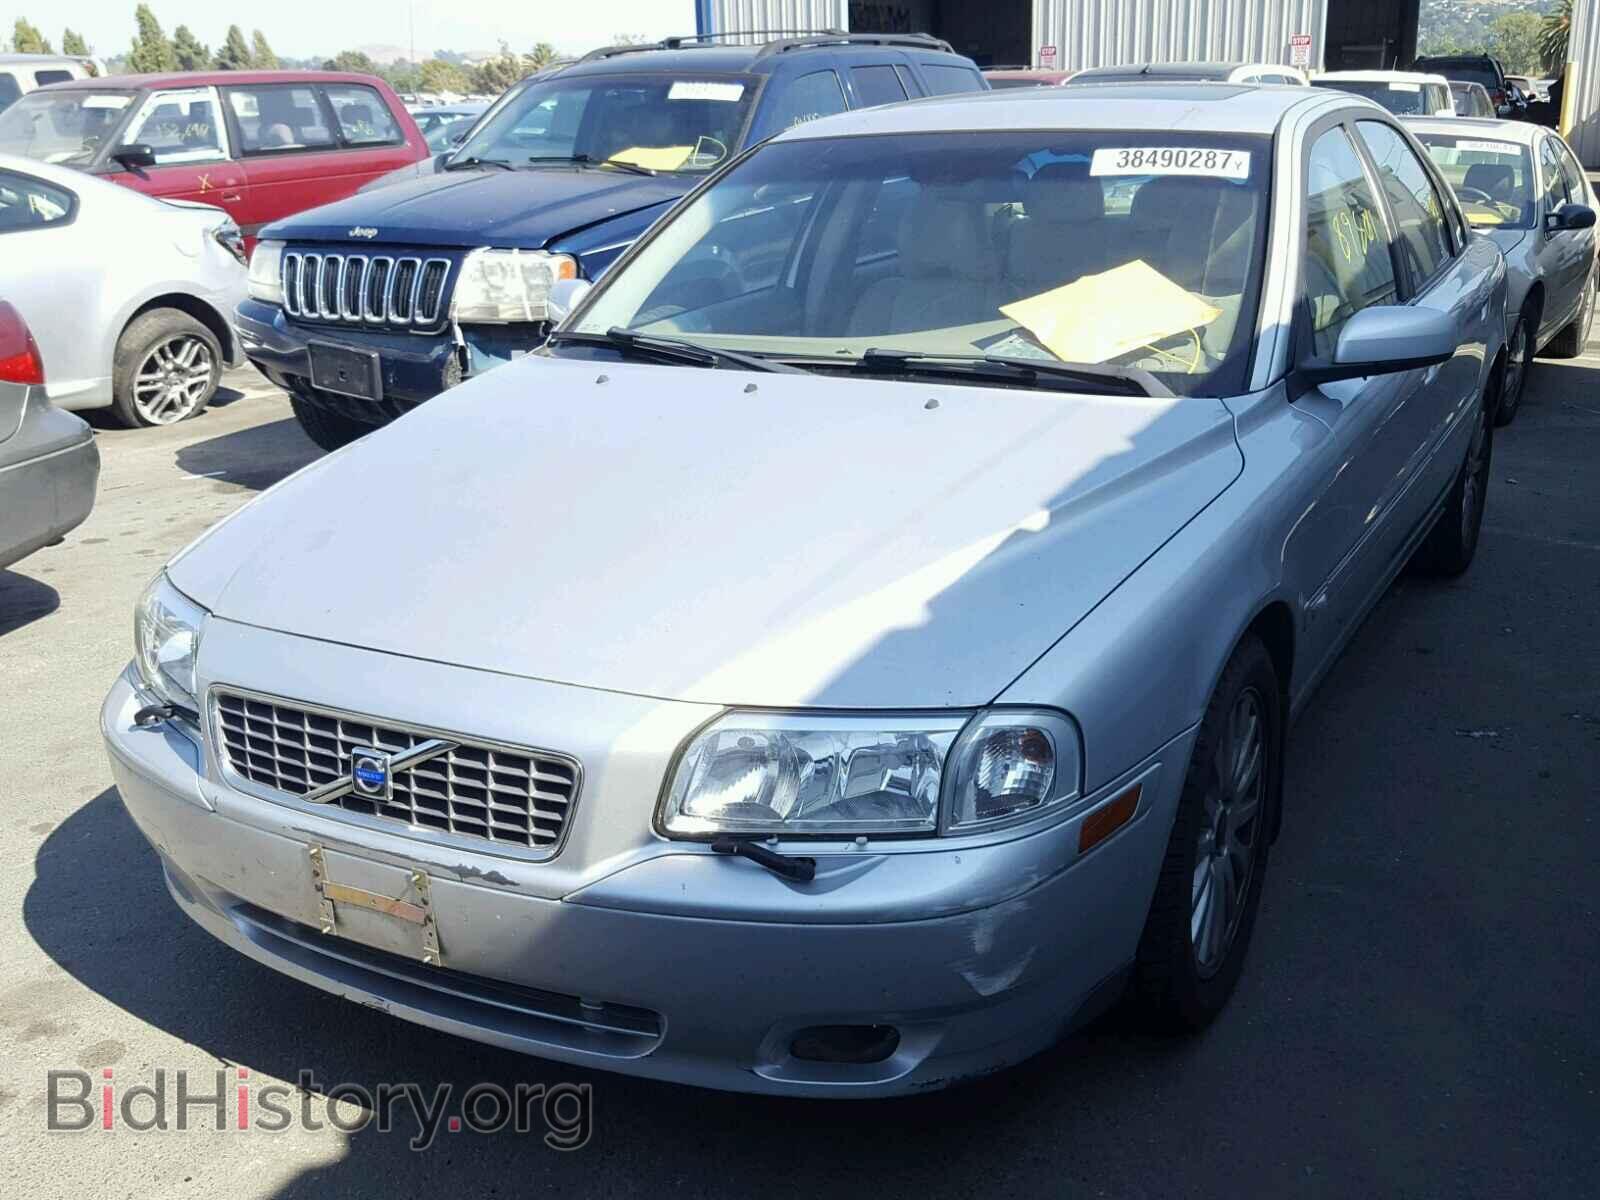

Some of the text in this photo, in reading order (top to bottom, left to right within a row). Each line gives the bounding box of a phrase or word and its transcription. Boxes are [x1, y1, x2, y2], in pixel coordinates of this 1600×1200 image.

[1292, 36, 1310, 46] STOP
[1041, 47, 1056, 56] STOP
[1116, 150, 1232, 169] 38490287
[348, 226, 378, 239] Jeep
